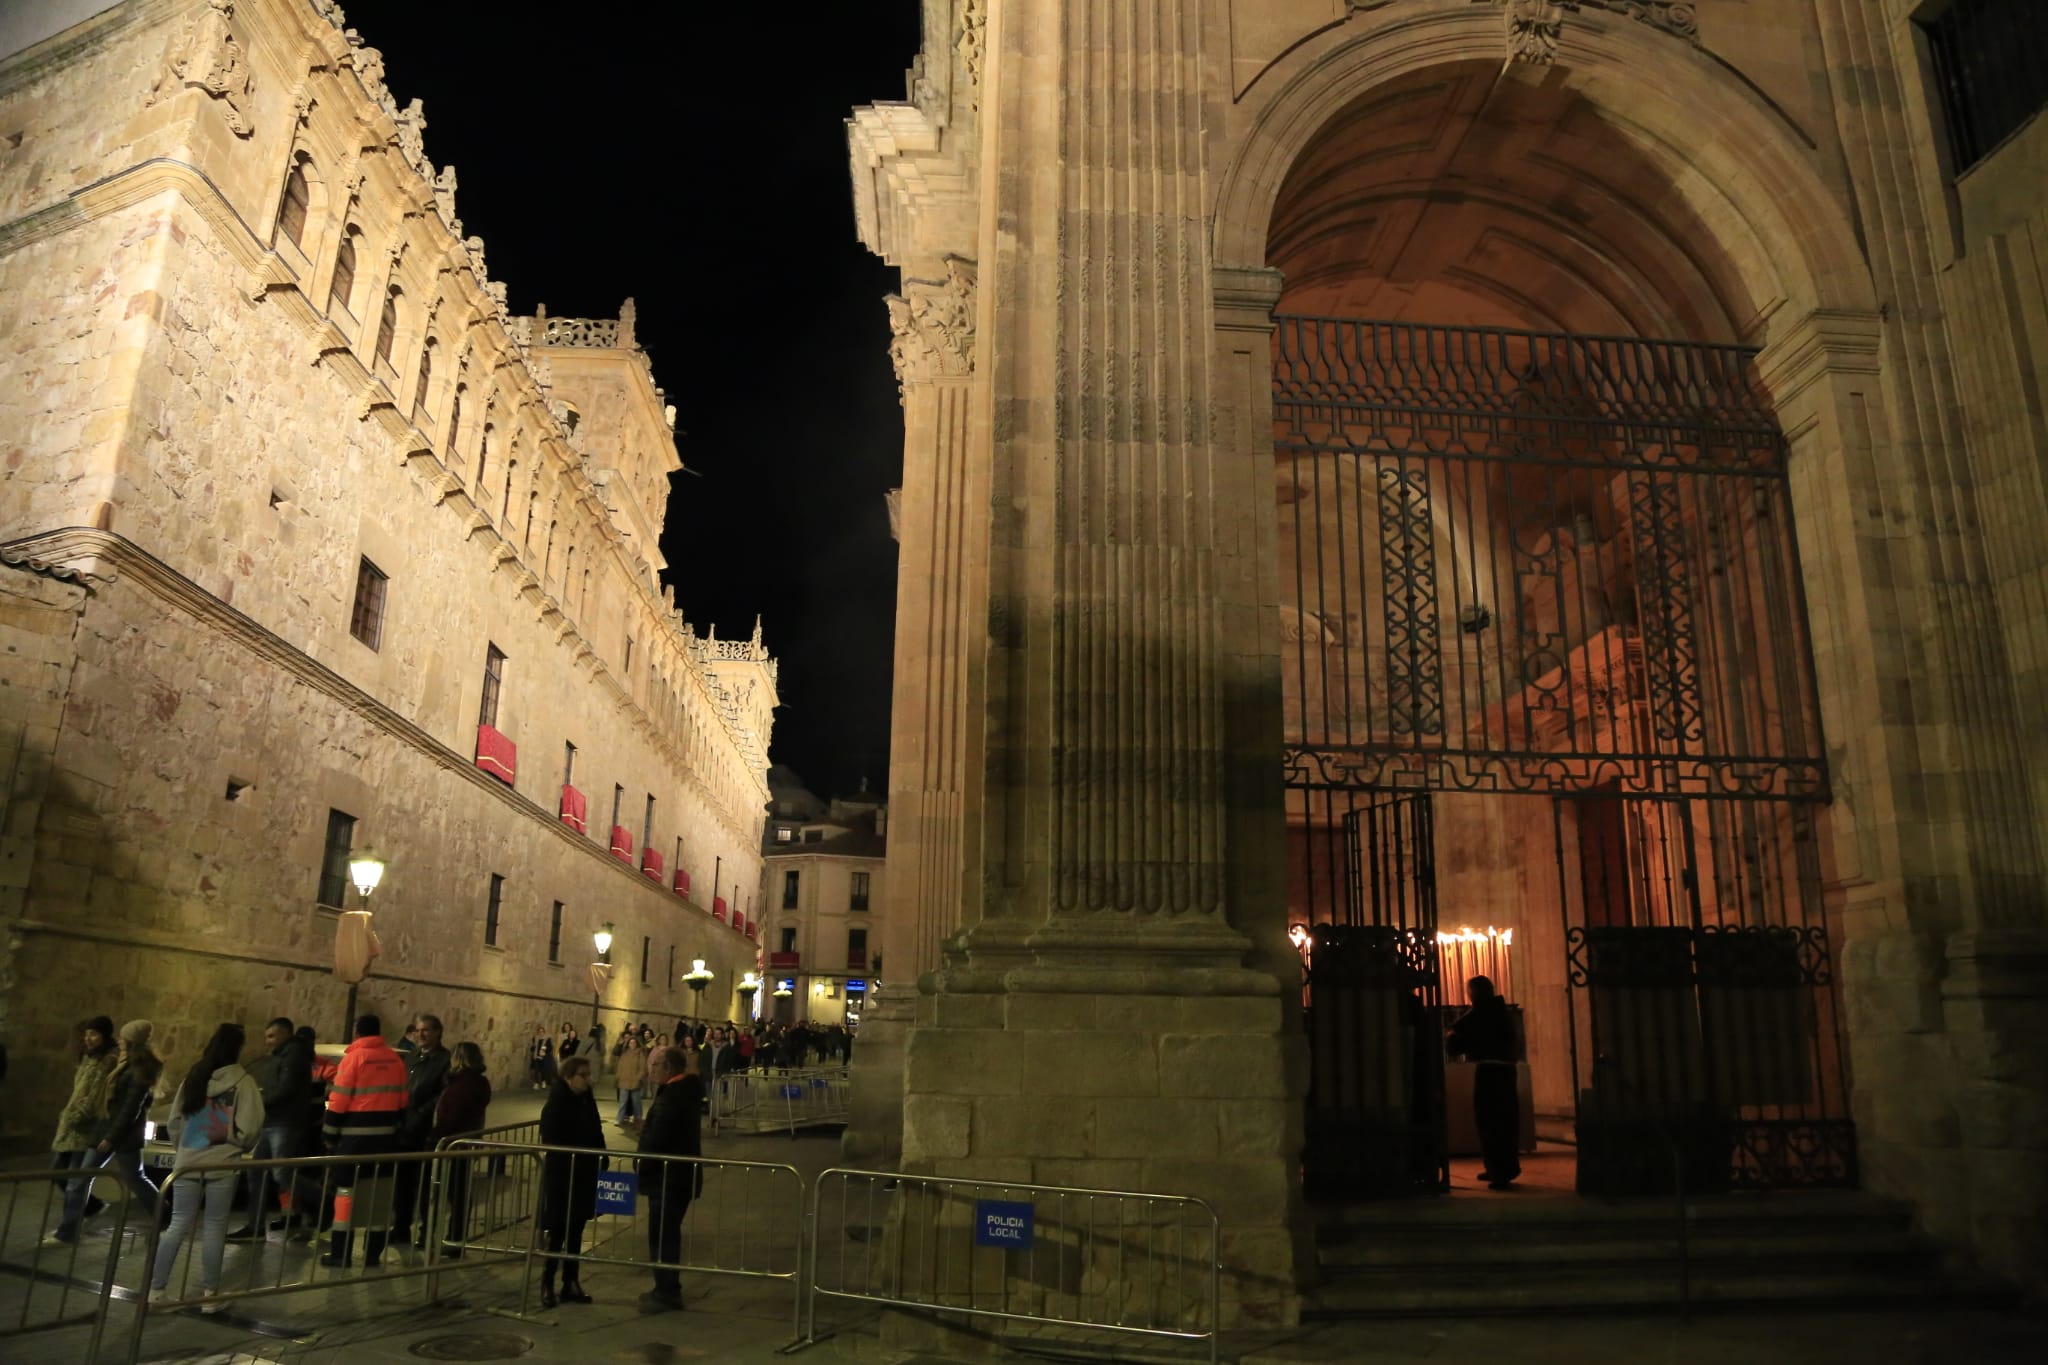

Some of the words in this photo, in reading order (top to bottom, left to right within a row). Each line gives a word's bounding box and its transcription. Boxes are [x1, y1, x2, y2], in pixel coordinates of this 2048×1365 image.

[597, 1180, 630, 1192] POLICIA
[598, 1191, 626, 1202] LOCAL
[987, 1215, 1024, 1228] POLICIA
[989, 1227, 1021, 1239] LOCAL
